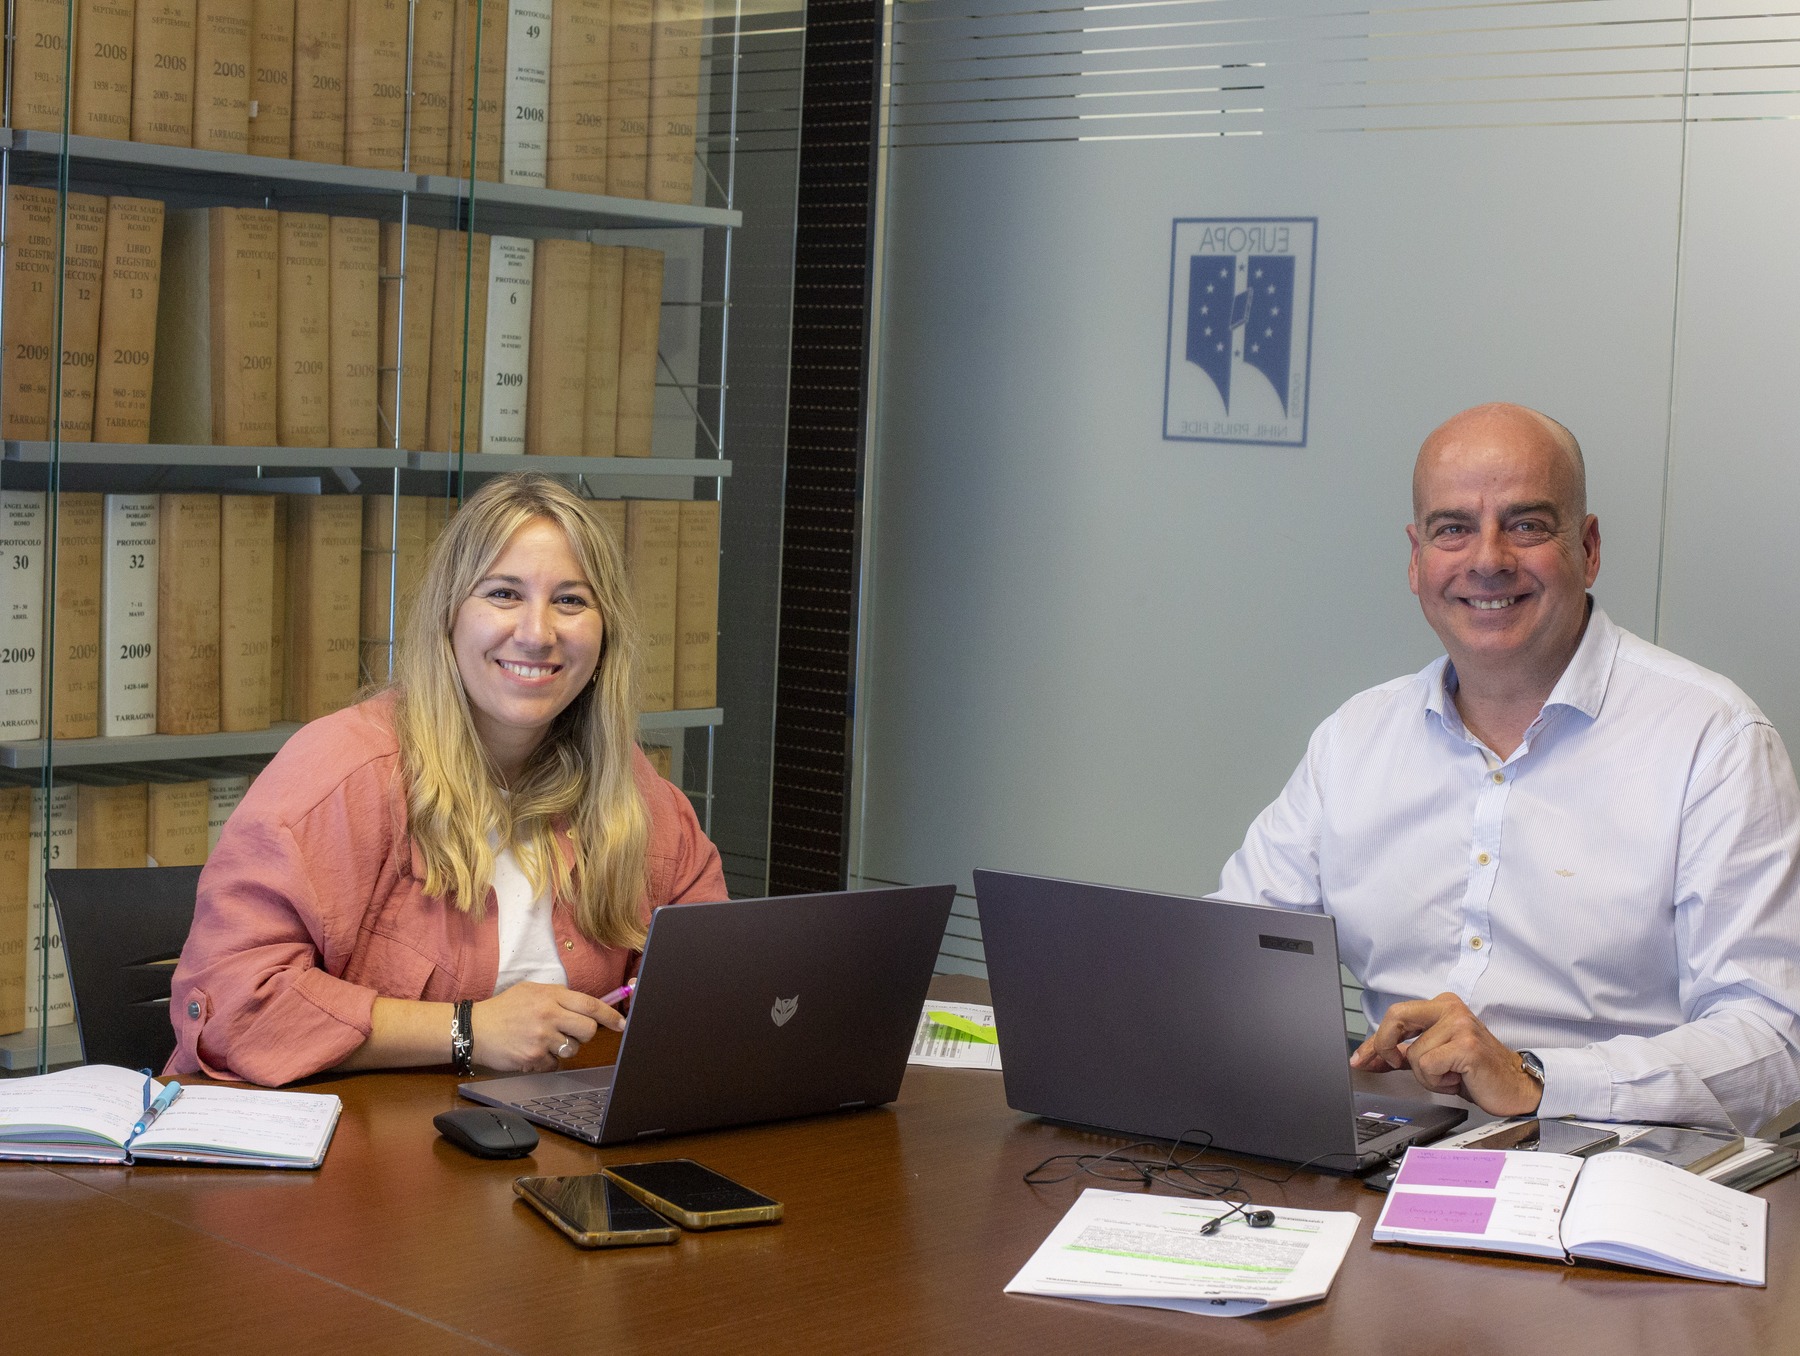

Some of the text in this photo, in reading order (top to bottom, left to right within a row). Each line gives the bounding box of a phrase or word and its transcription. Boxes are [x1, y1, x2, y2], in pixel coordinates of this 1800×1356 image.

[514, 8, 550, 20] PROTOCOLO
[526, 24, 541, 39] 49
[94, 42, 128, 61] 2008
[154, 53, 187, 72] 2008
[213, 60, 246, 79] 2008
[257, 68, 288, 86] 2008
[312, 75, 342, 92] 2008
[372, 82, 402, 99] 2008
[420, 91, 447, 109] 2008
[516, 105, 545, 123] 2008
[575, 112, 602, 128] 2008
[667, 121, 693, 137] 2008
[112, 203, 138, 212] ANGEL
[28, 214, 51, 224] ROMO
[76, 223, 99, 233] ROMO
[127, 223, 151, 232] ROMO
[28, 235, 52, 247] LIBRO
[75, 243, 99, 256] LIBRO
[127, 243, 151, 255] LIBRO
[15, 261, 50, 273] SECCION
[116, 256, 157, 269] REGISTRO
[113, 269, 150, 282] SECCION
[306, 274, 313, 286] 2
[495, 276, 530, 285] PROTOCOLO
[31, 281, 43, 293] 11
[78, 288, 91, 301] 12
[130, 287, 144, 300] 13
[509, 291, 518, 306] 6
[16, 344, 50, 361] 2009
[62, 350, 95, 368] 2009
[113, 349, 150, 367] 2009
[243, 355, 272, 370] 2009
[294, 360, 323, 375] 2009
[346, 363, 376, 378] 2009
[496, 372, 523, 387] 2009
[0, 538, 42, 547] PROTOCOLO
[116, 538, 157, 547] PROTOCOLO
[12, 554, 29, 571] 30
[129, 554, 145, 569] 32
[327, 638, 356, 653] 2009
[684, 632, 710, 646] 2009
[2, 647, 36, 664] 2009
[68, 643, 98, 661] 2009
[120, 643, 152, 660] 2009
[4, 850, 16, 861] 62
[0, 939, 24, 956] 009
